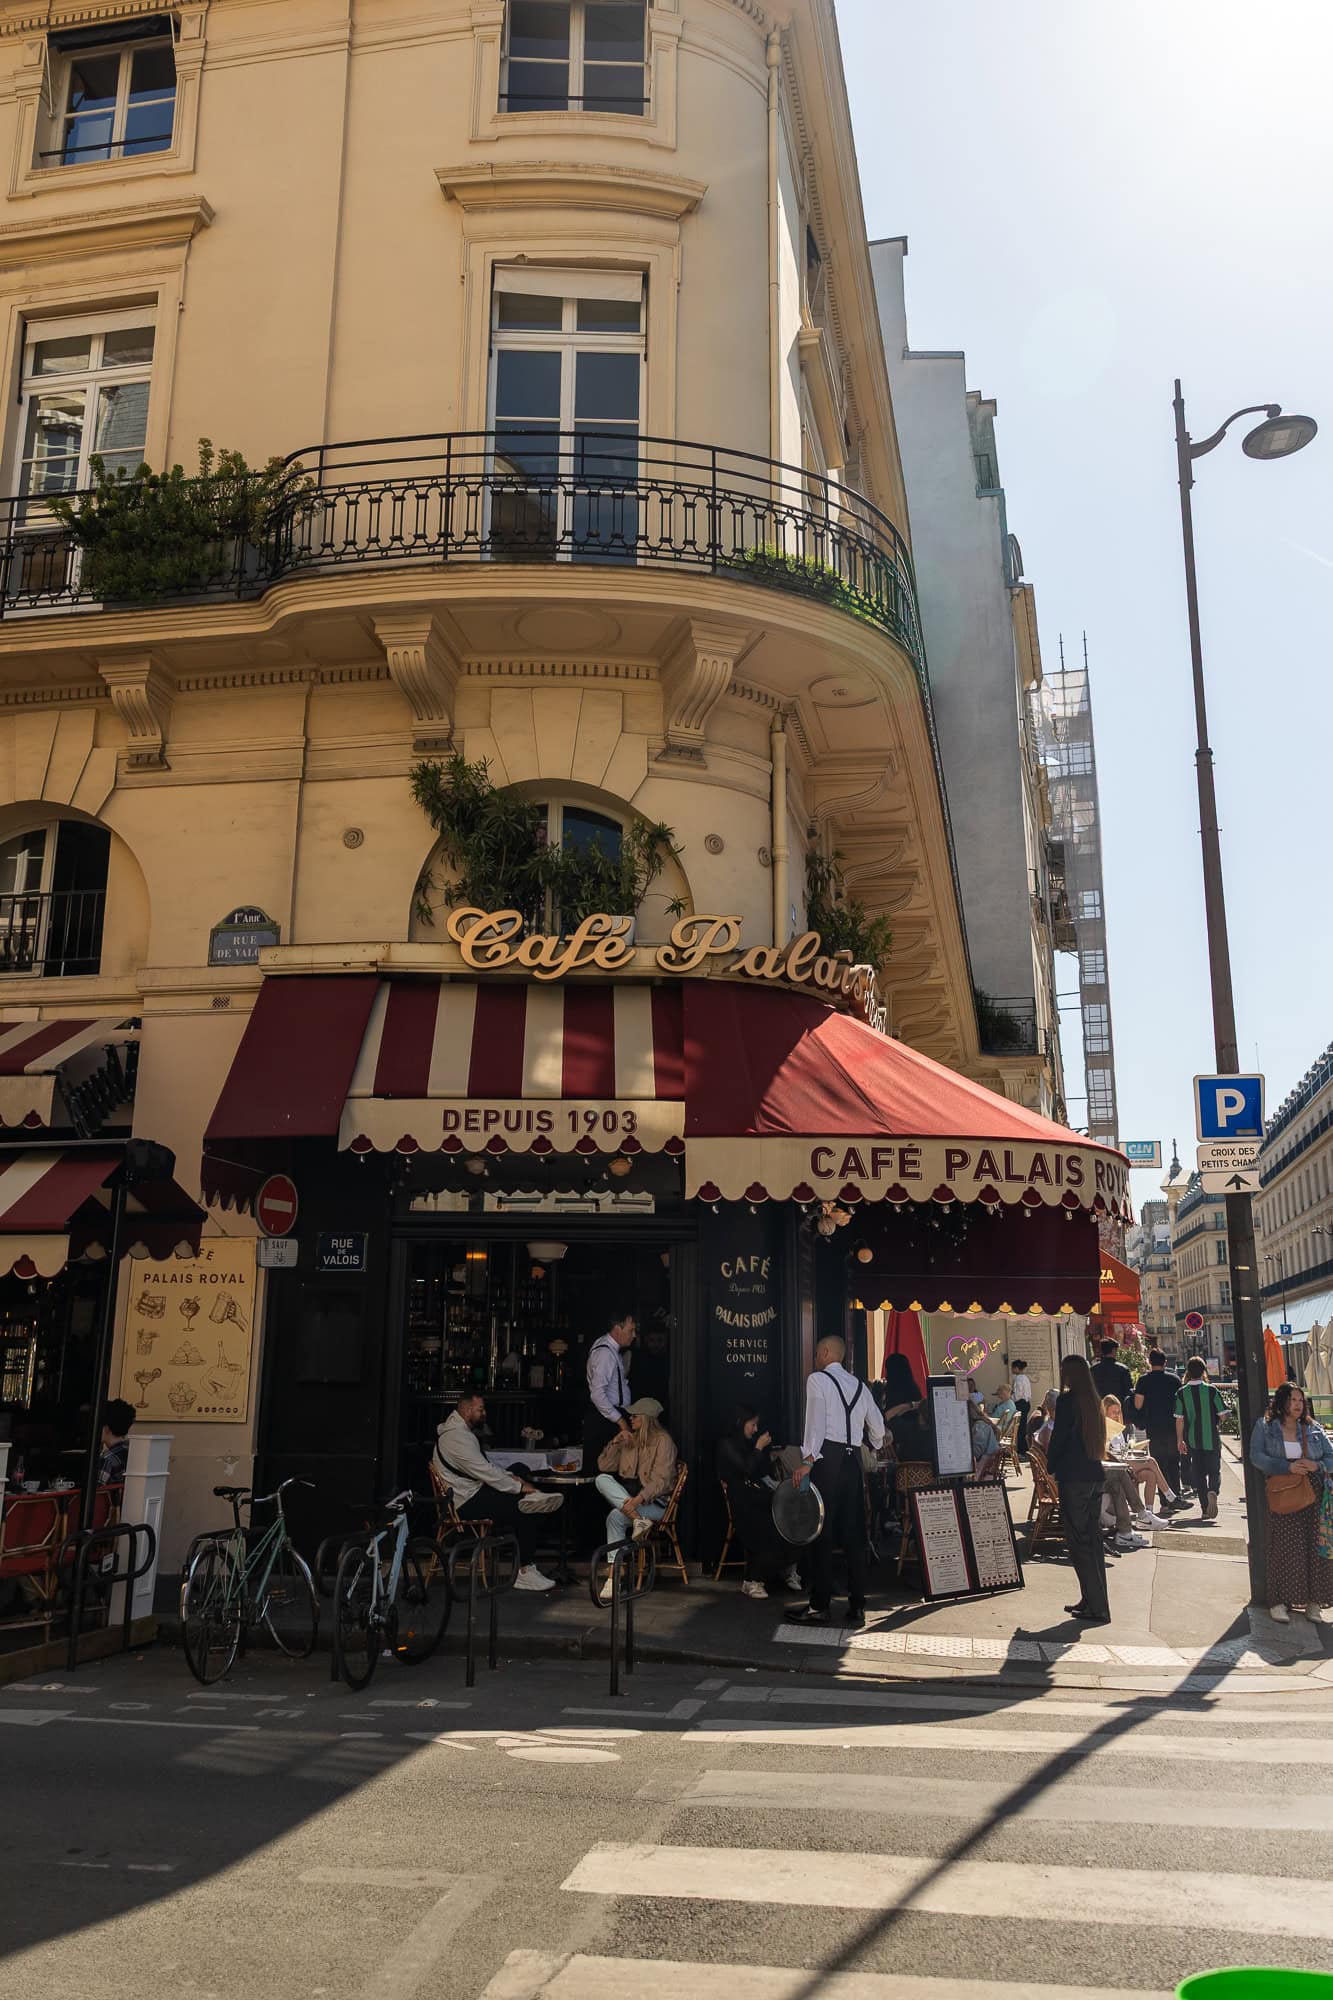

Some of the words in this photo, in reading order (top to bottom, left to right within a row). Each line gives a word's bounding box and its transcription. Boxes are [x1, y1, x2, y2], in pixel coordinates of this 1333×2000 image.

[233, 935, 257, 945] RUE
[217, 949, 232, 959] DE
[446, 905, 636, 981] Café
[655, 913, 863, 1001] Palais
[1216, 1088, 1246, 1128] P
[442, 1108, 555, 1133] DEPUIS
[567, 1109, 638, 1134] 1903
[1211, 1147, 1236, 1157] CROIX
[1238, 1147, 1256, 1156] DES
[810, 1143, 923, 1181] CAFÉ
[944, 1148, 1086, 1188] PALAIS
[1201, 1159, 1230, 1169] PETITS
[331, 1239, 354, 1249] RUE
[323, 1255, 360, 1265] VALOIS
[720, 1255, 771, 1280] CAFÉ
[143, 1272, 193, 1284] PALAIS
[199, 1272, 246, 1285] ROYAL
[714, 1304, 751, 1329] PALAIS
[751, 1305, 777, 1328] ROYAL
[726, 1338, 769, 1349] SERVICE
[726, 1353, 769, 1364] CONTINU
